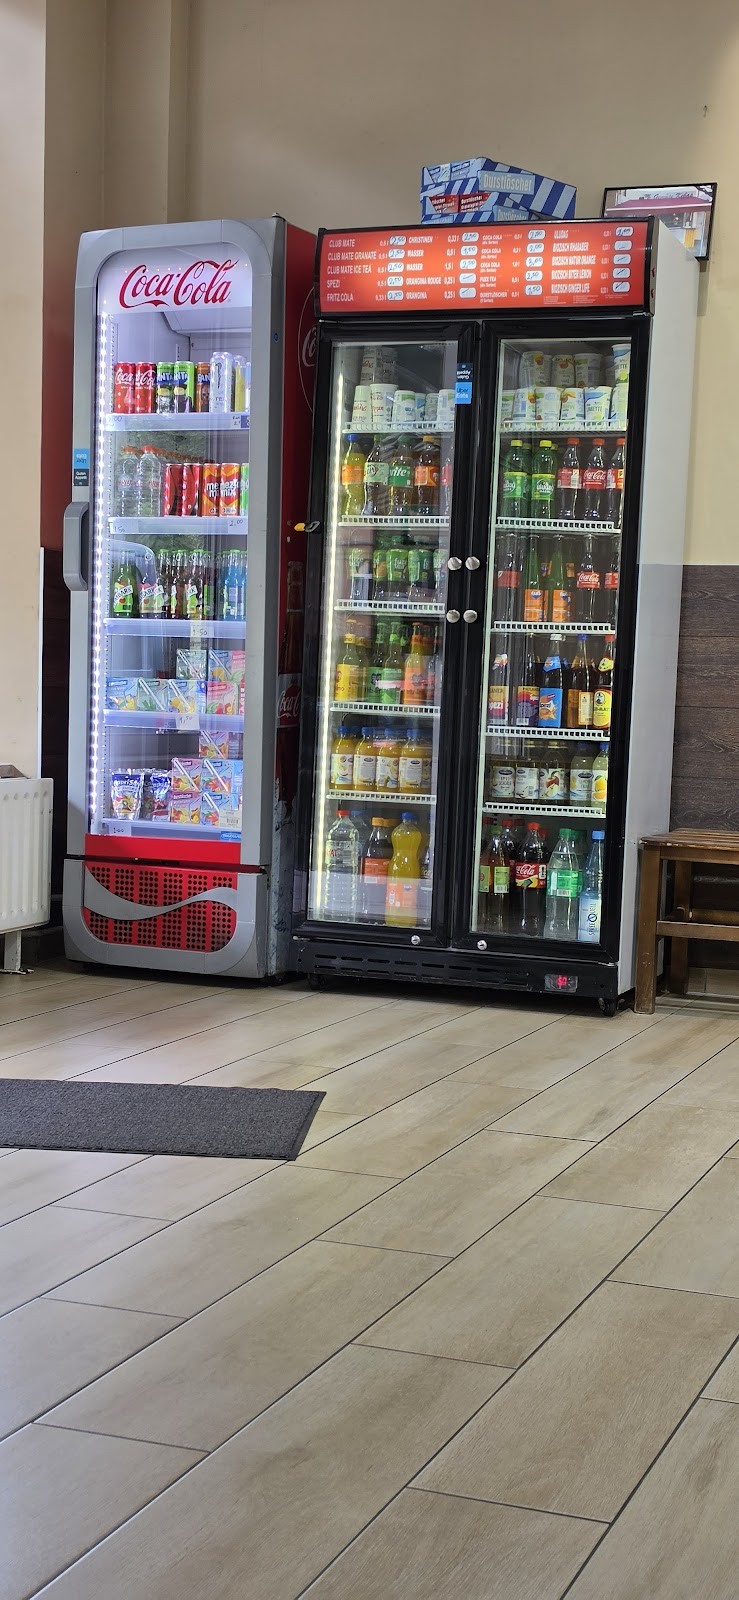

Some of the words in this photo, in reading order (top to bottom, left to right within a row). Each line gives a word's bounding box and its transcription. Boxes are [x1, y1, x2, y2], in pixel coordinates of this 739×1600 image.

[483, 174, 532, 192] Durstlöscher
[355, 251, 377, 259] GRANATE
[327, 266, 340, 274] CLUB
[340, 266, 353, 274] MATE
[362, 265, 372, 273] TEA
[118, 259, 240, 308] Coca-Cola
[327, 280, 340, 288] SPEZI
